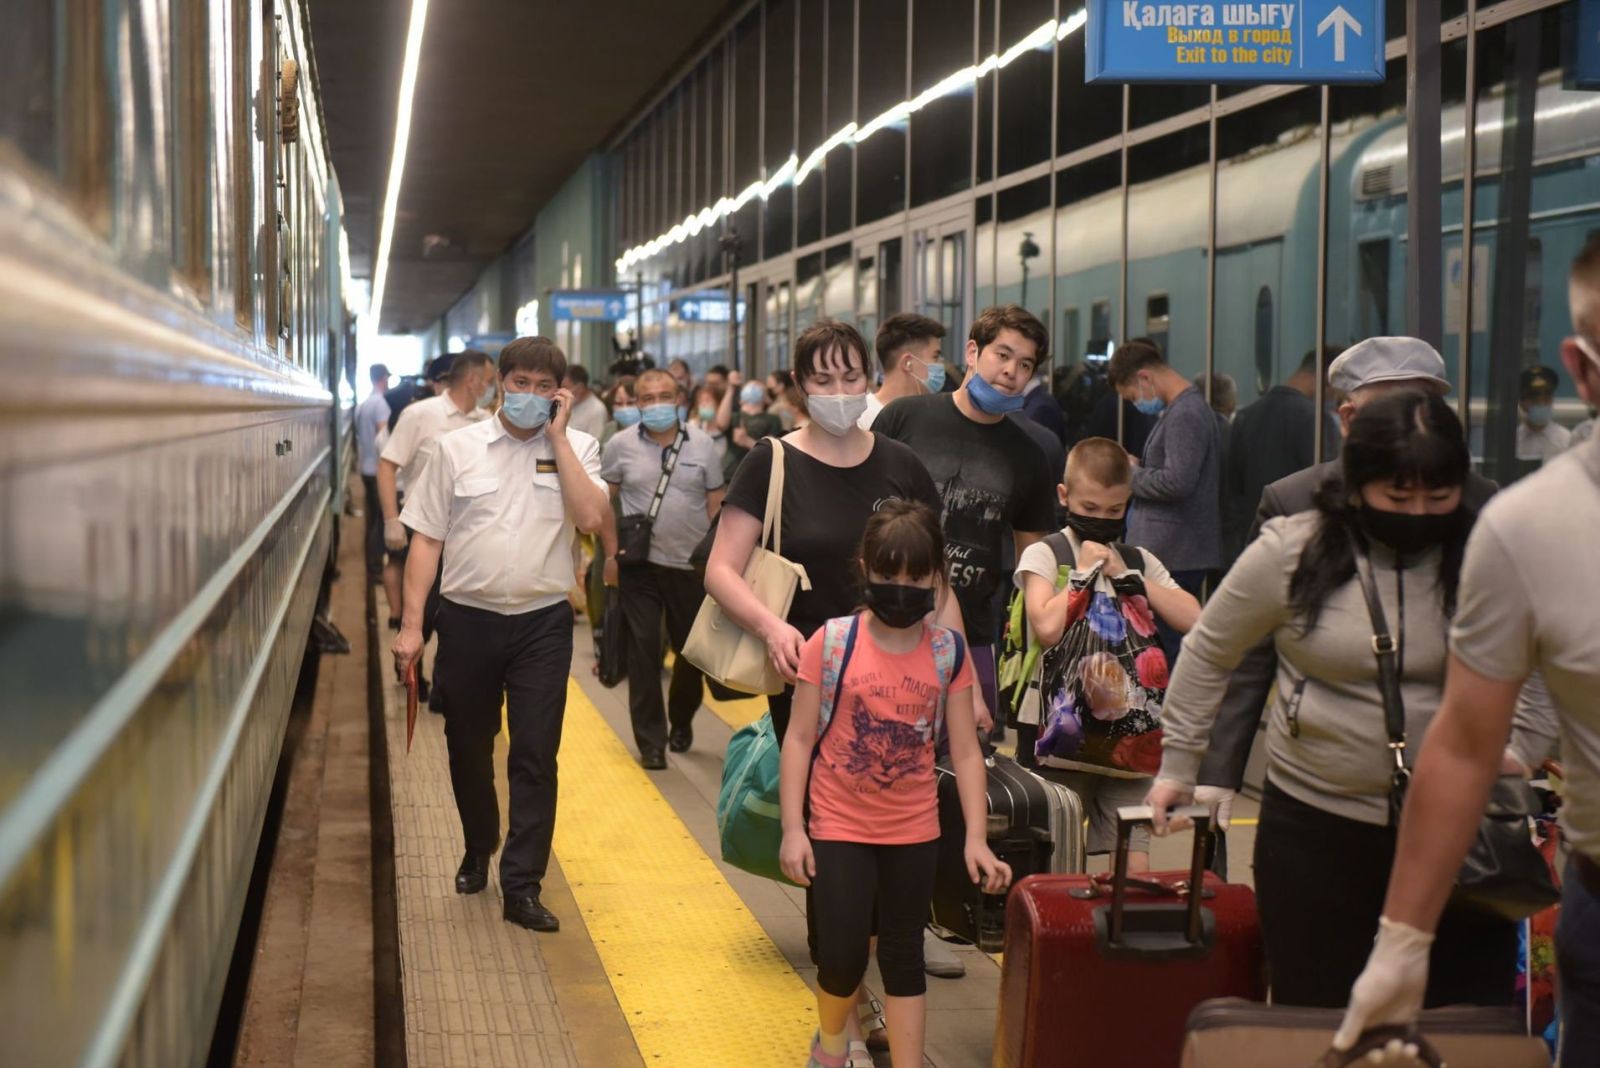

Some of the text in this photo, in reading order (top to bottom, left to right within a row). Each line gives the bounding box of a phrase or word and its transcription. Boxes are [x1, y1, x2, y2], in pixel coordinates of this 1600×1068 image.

[1123, 0, 1294, 30] Қалаға шығу
[1167, 26, 1292, 45] Выход в город
[1176, 46, 1292, 65] Exit to the city
[946, 562, 986, 588] EST
[868, 685, 897, 698] SWEET
[901, 675, 936, 700] MIAO
